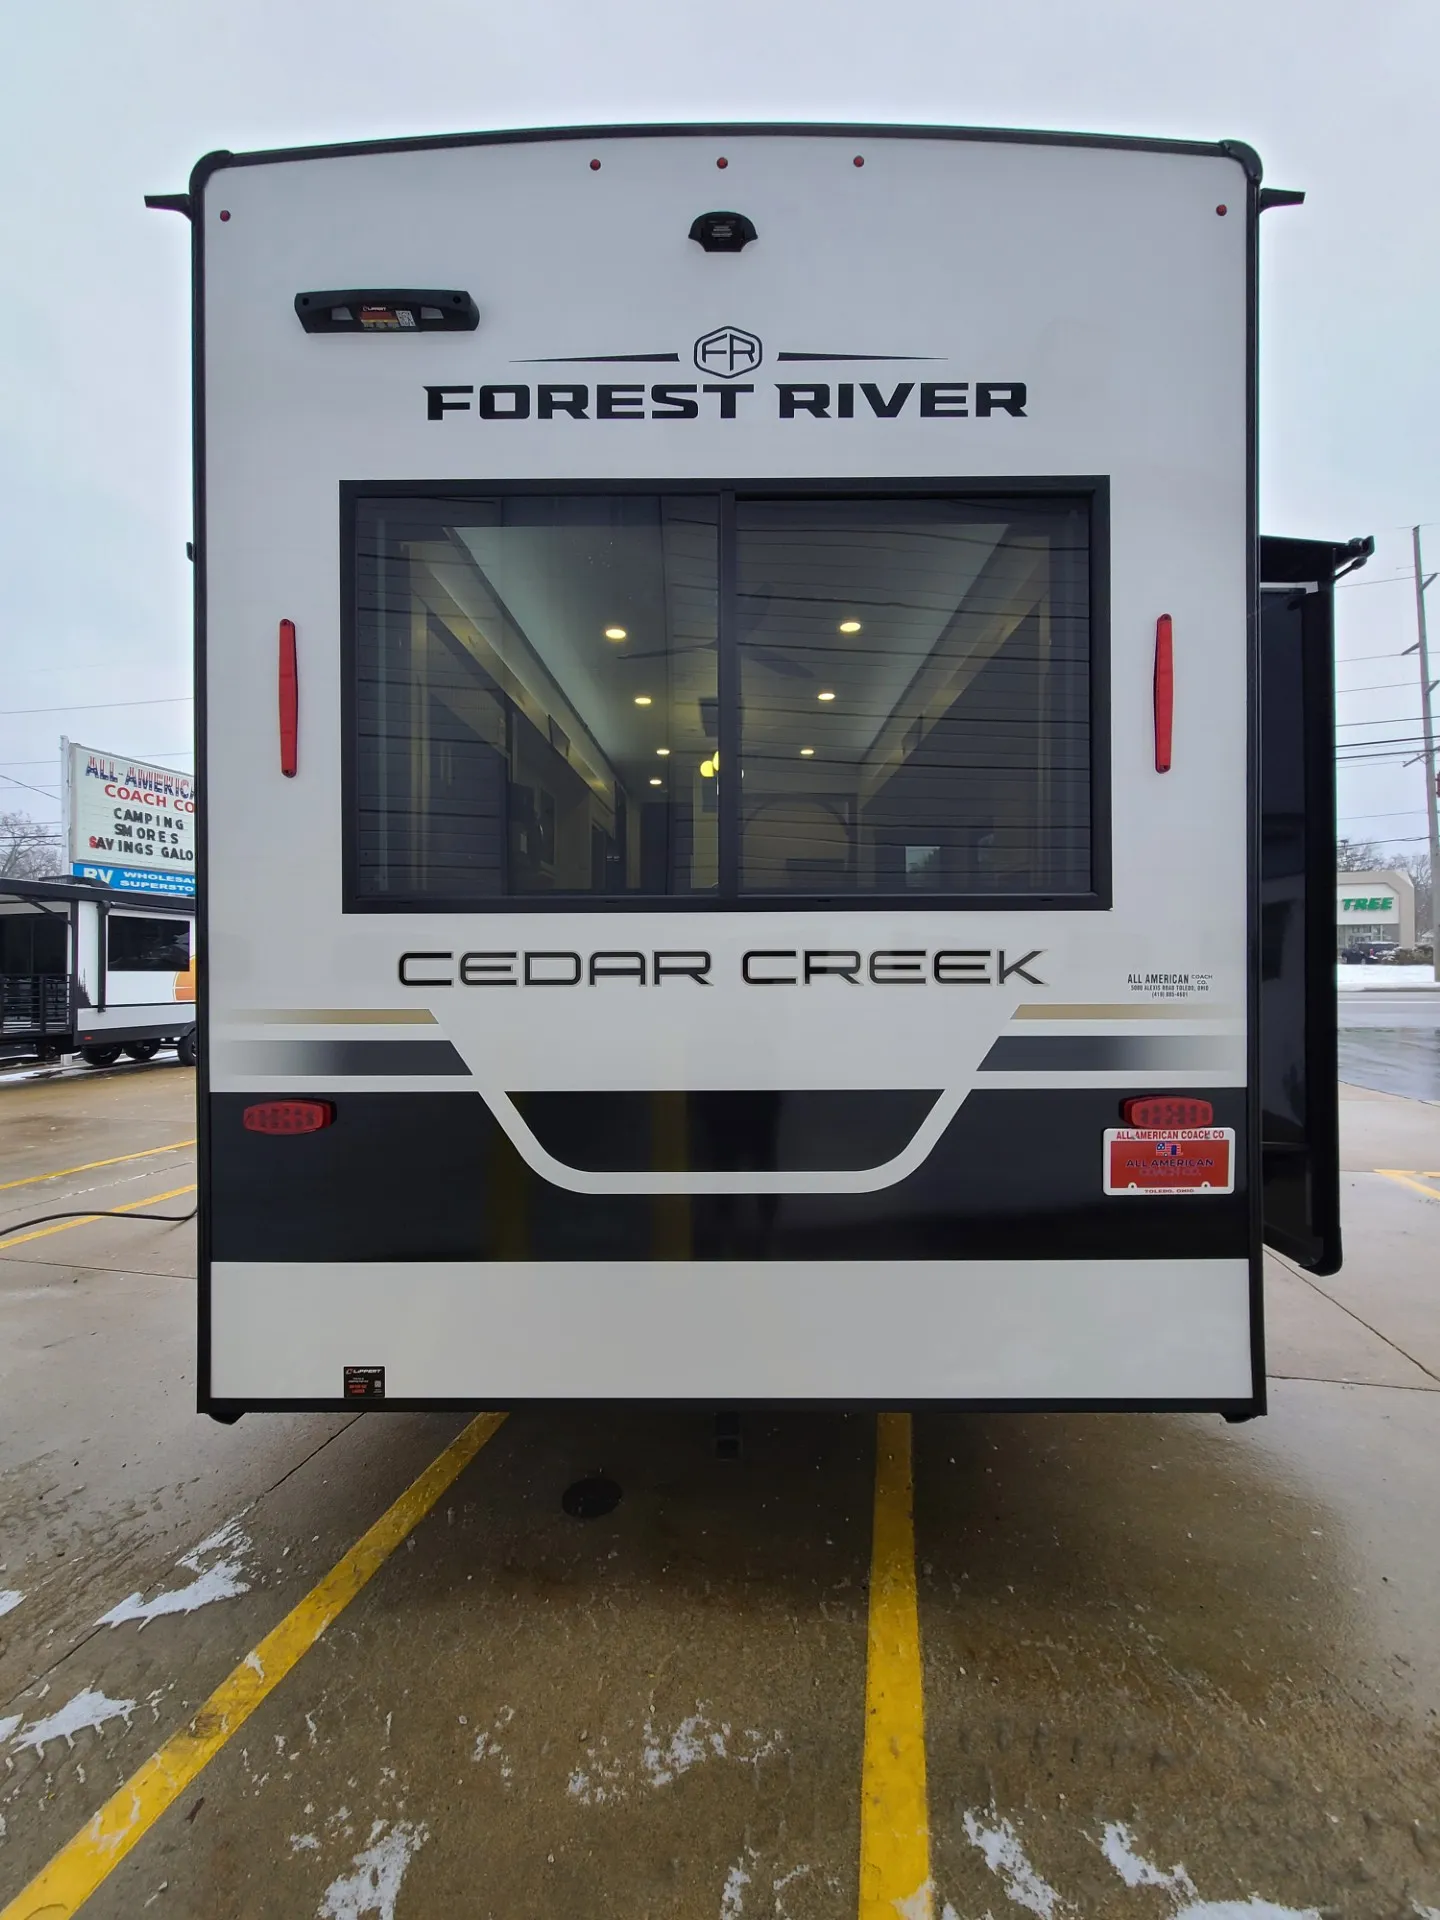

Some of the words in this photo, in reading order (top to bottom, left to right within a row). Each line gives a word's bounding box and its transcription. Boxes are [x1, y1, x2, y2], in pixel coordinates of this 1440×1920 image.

[422, 383, 755, 421] FOREST
[773, 382, 1029, 419] RIVER
[104, 784, 167, 808] COACH
[113, 807, 184, 830] CAMPING
[88, 835, 154, 856] SAVINGS
[83, 867, 114, 884] RV
[119, 880, 194, 892] SUPERSTO
[1341, 897, 1394, 911] TREE
[398, 951, 713, 986] CEDAR
[741, 949, 1048, 985] CREEK
[1127, 973, 1143, 984] ALL
[1145, 973, 1189, 984] AMERICAN
[1116, 1131, 1131, 1139] ALL
[1134, 1131, 1179, 1140] AMERICAN
[1181, 1130, 1210, 1140] COACH
[1212, 1130, 1225, 1139] CO
[1126, 1159, 1147, 1168] ALL
[1150, 1159, 1214, 1167] AMERICAN
